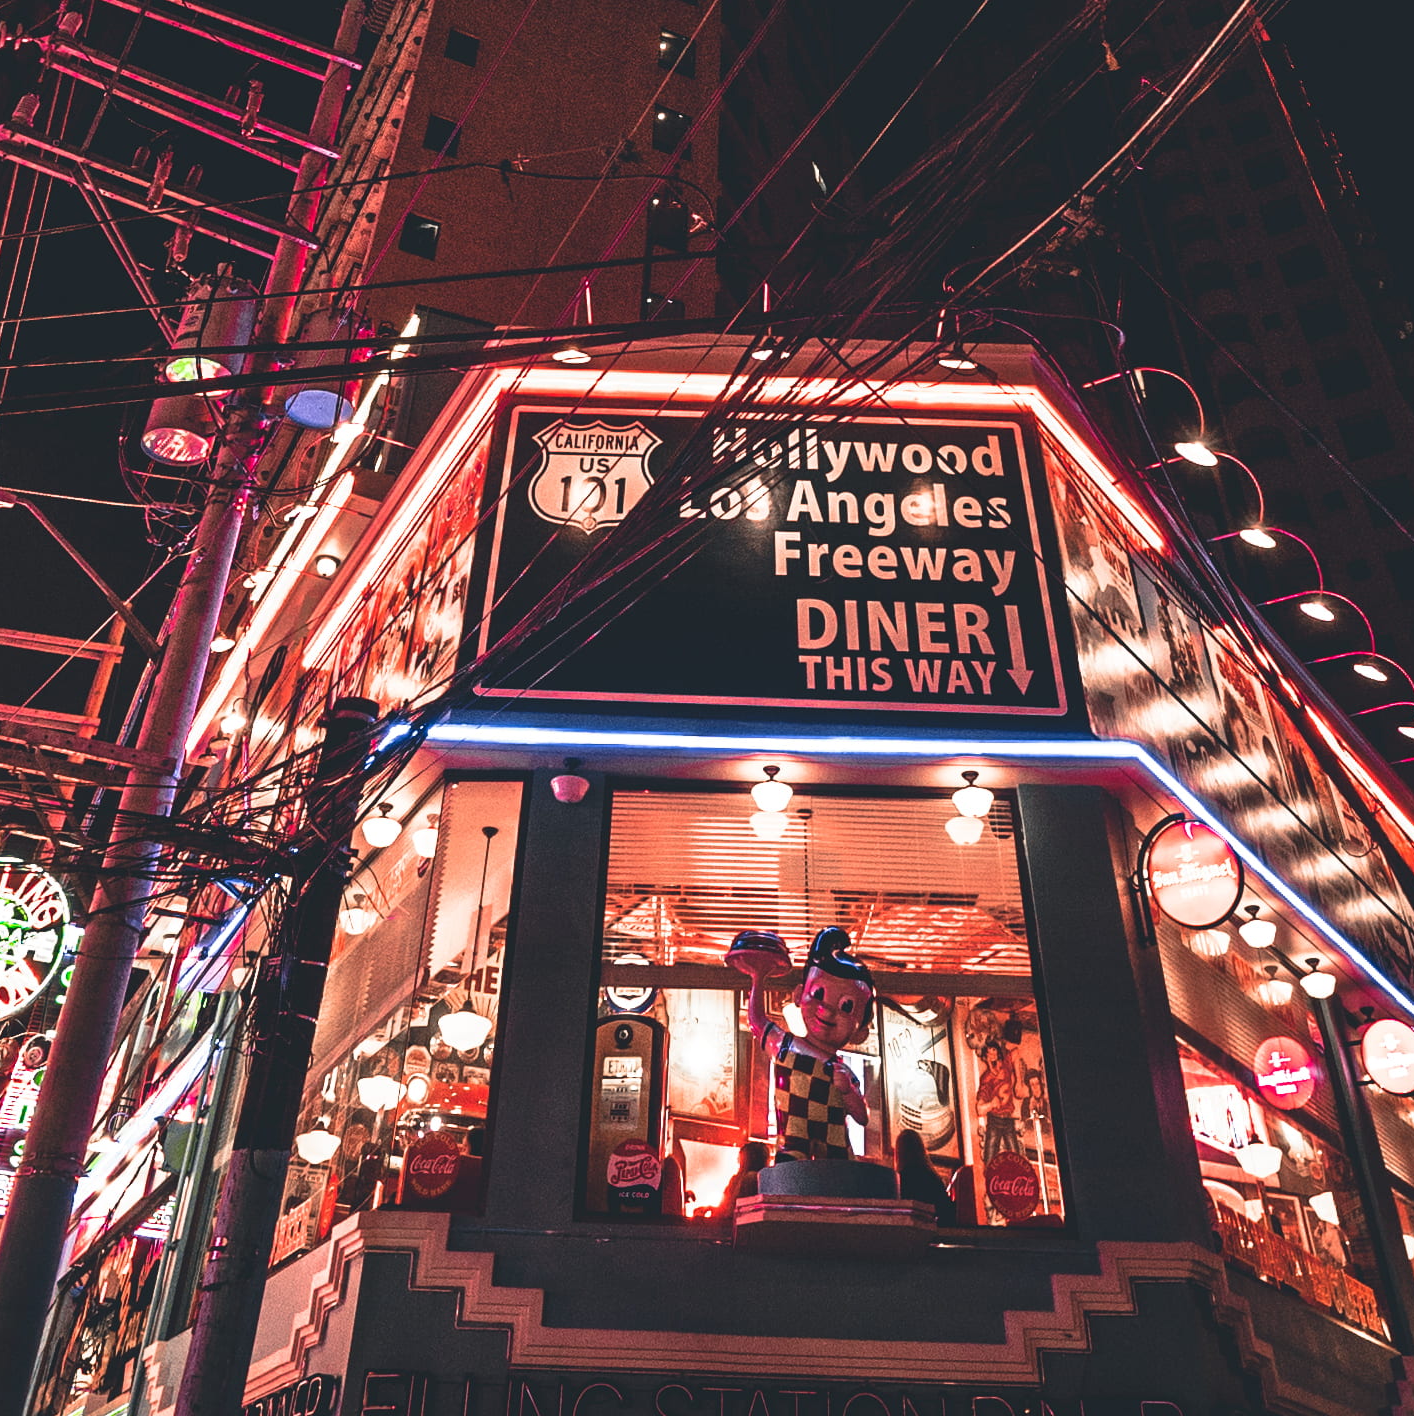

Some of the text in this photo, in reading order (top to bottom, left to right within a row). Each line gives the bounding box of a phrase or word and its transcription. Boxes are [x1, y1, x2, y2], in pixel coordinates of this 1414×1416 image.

[555, 433, 639, 451] CALIFORNIA
[579, 457, 611, 473] US
[712, 427, 1004, 482] Hollywood
[560, 475, 627, 514] 101
[787, 479, 1012, 536] Angeles
[774, 531, 1016, 596] Freeway
[796, 598, 995, 655] DINER
[798, 654, 997, 696] THIS WAY
